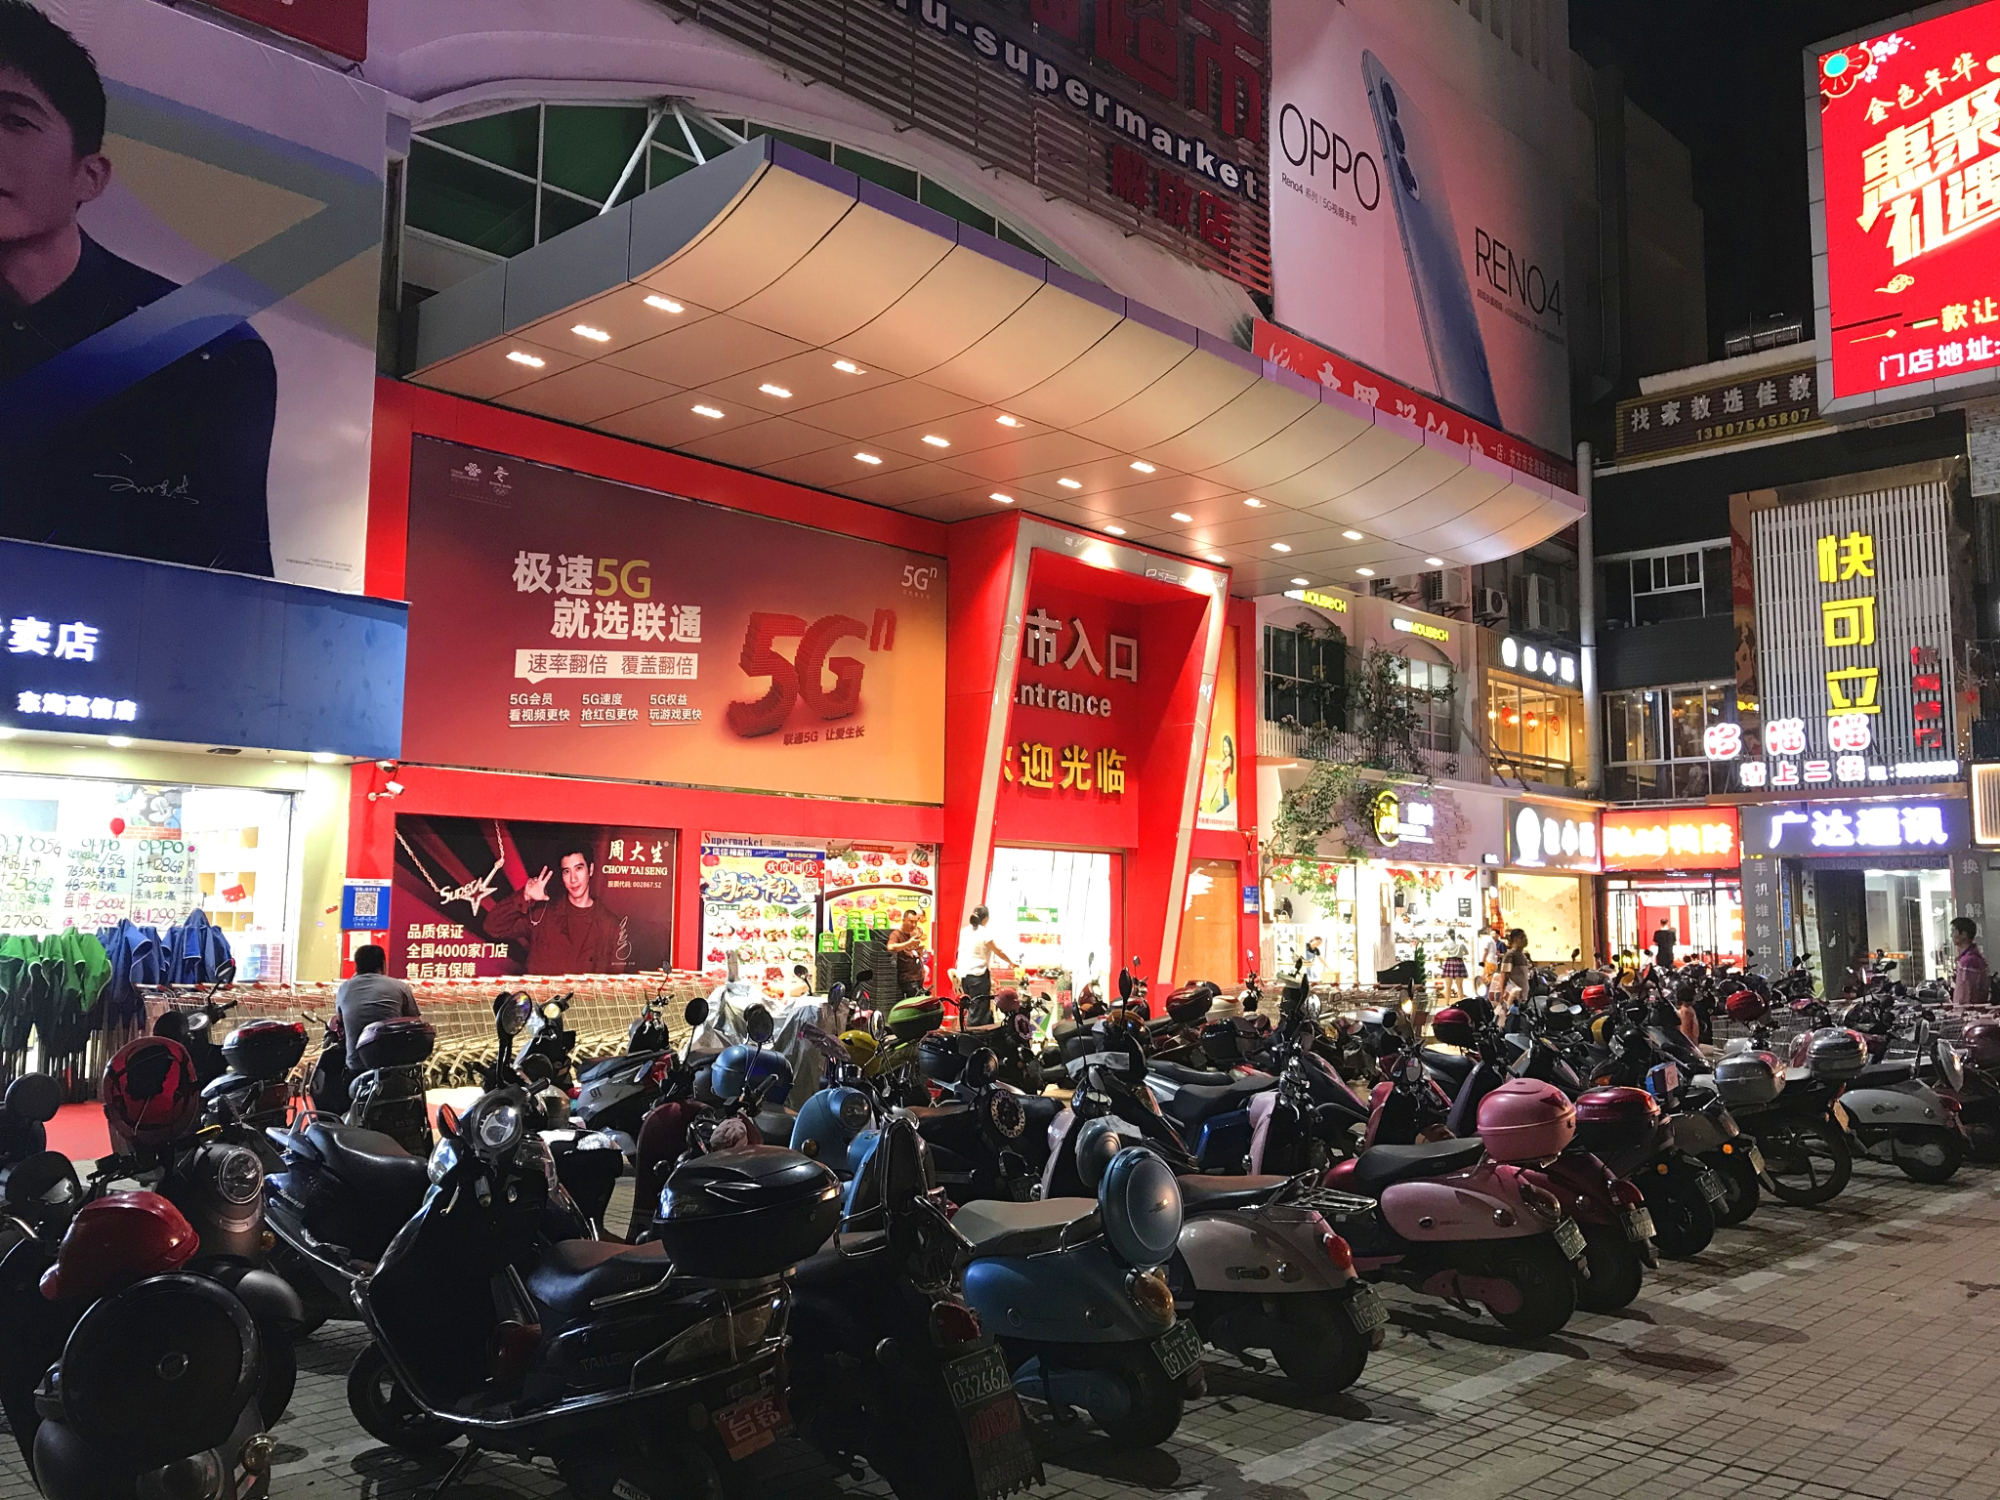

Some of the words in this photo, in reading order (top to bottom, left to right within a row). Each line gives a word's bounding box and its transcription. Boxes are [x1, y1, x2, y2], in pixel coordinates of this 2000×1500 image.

[896, 0, 1259, 200] u-supermarket
[1864, 52, 1980, 126] 金色年华
[1278, 102, 1381, 212] OPPO
[1281, 172, 1304, 196] Reno4
[1475, 226, 1564, 326] RENO4
[1630, 372, 1812, 432] 找家教选佳教
[1696, 407, 1811, 441] 13807545807
[512, 550, 652, 599] 极速5G
[550, 596, 703, 644] 就选联通
[1817, 531, 1882, 716] 快可立
[0, 614, 99, 662] 卖店
[527, 652, 608, 675] 速率翻倍
[620, 653, 694, 677] 覆盖翻倍
[508, 707, 571, 723] 看视频更快
[580, 707, 639, 722] 抢红包更快
[648, 707, 703, 722] 玩游戏更快
[509, 692, 554, 706] 5G会员
[582, 692, 623, 706] 5G速度
[649, 692, 688, 707] 5G权益
[1014, 682, 1112, 718] ntrance
[824, 724, 866, 744] 让爱生长
[703, 832, 764, 847] Supermarket
[1768, 806, 1949, 849] 广达通讯
[138, 839, 185, 856] OPPO
[607, 838, 665, 864] 周大生
[602, 864, 629, 876] CHOW
[630, 865, 644, 876] TAI
[644, 866, 668, 877] SENG
[764, 860, 819, 876] 欢度国庆
[705, 869, 801, 904] 月满中秋
[406, 924, 464, 940] 品质保证
[1753, 862, 1774, 978] 手机维修中心
[406, 943, 509, 959] 全国4000家门店
[405, 962, 476, 979] 售后有保障
[1163, 1336, 1205, 1375] 091152
[952, 1365, 1011, 1404] 032662
